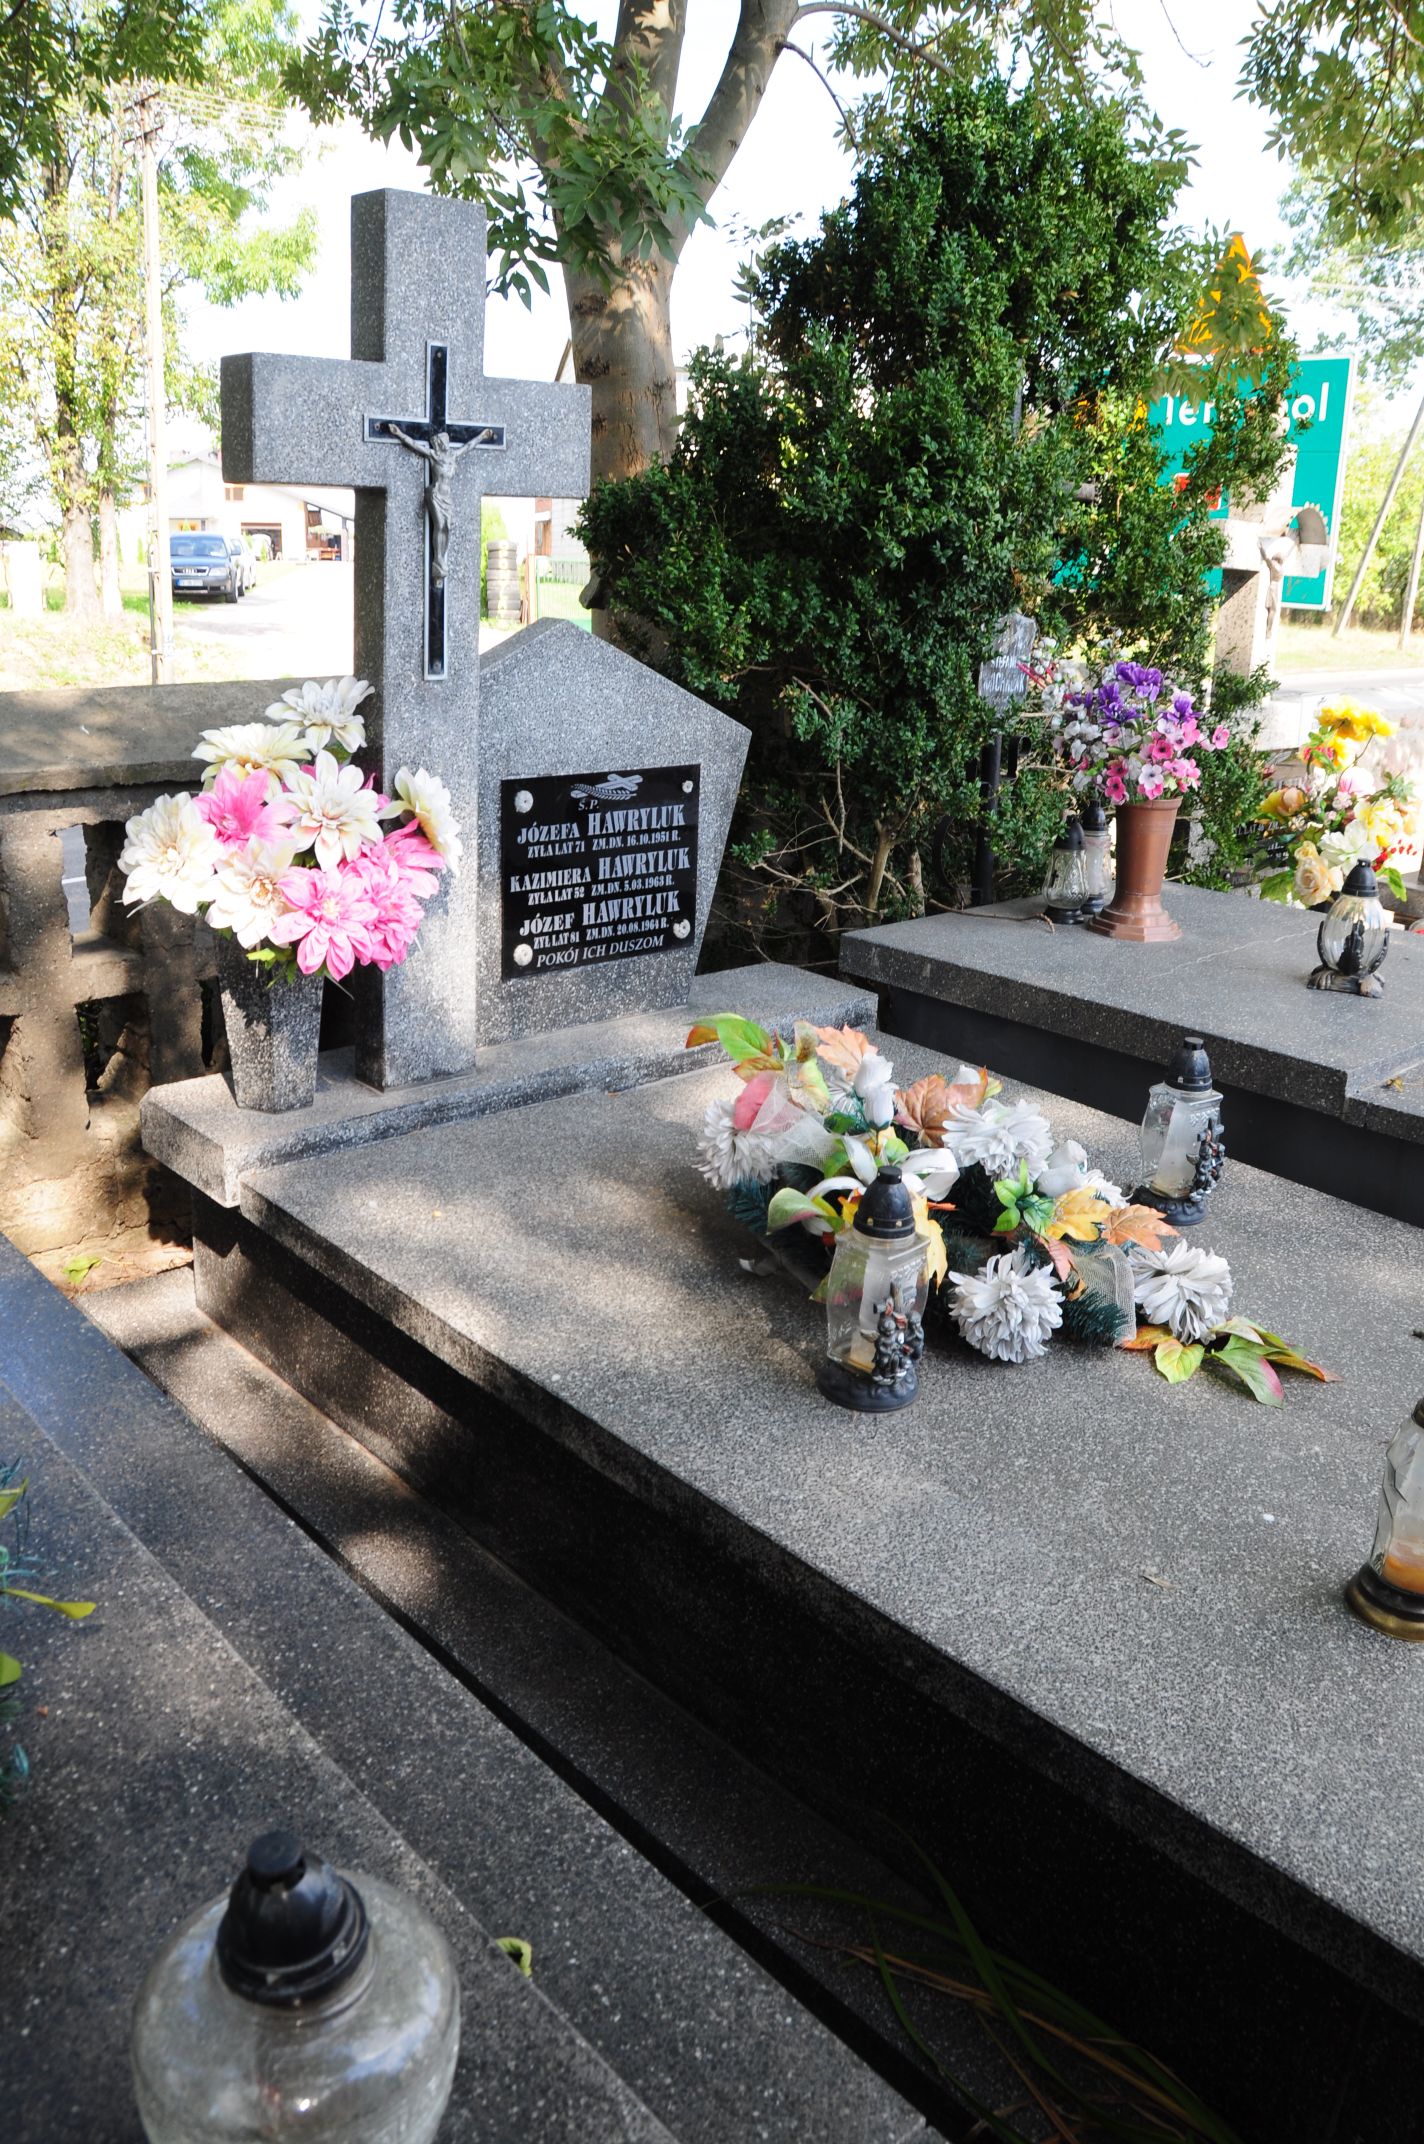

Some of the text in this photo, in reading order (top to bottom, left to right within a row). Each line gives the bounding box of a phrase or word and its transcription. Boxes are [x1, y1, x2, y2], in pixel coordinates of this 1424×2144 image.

[517, 804, 686, 844] JÓZEFA HAWRYLUK
[555, 841, 574, 855] LAT
[575, 840, 585, 852] 71
[627, 831, 669, 847] 16.10.1951
[672, 830, 681, 841] R.
[510, 847, 690, 892] KAZIMIERA HAWRYLUK
[555, 887, 573, 902] LAT
[574, 886, 585, 899] 52
[665, 875, 675, 886] R.
[519, 890, 680, 936] JÓZEF HAWRYLUK
[552, 932, 570, 947] LAT
[570, 931, 580, 943] 81
[660, 917, 669, 928] R.
[536, 934, 665, 968] POKÓJ ICH DUSZOM
